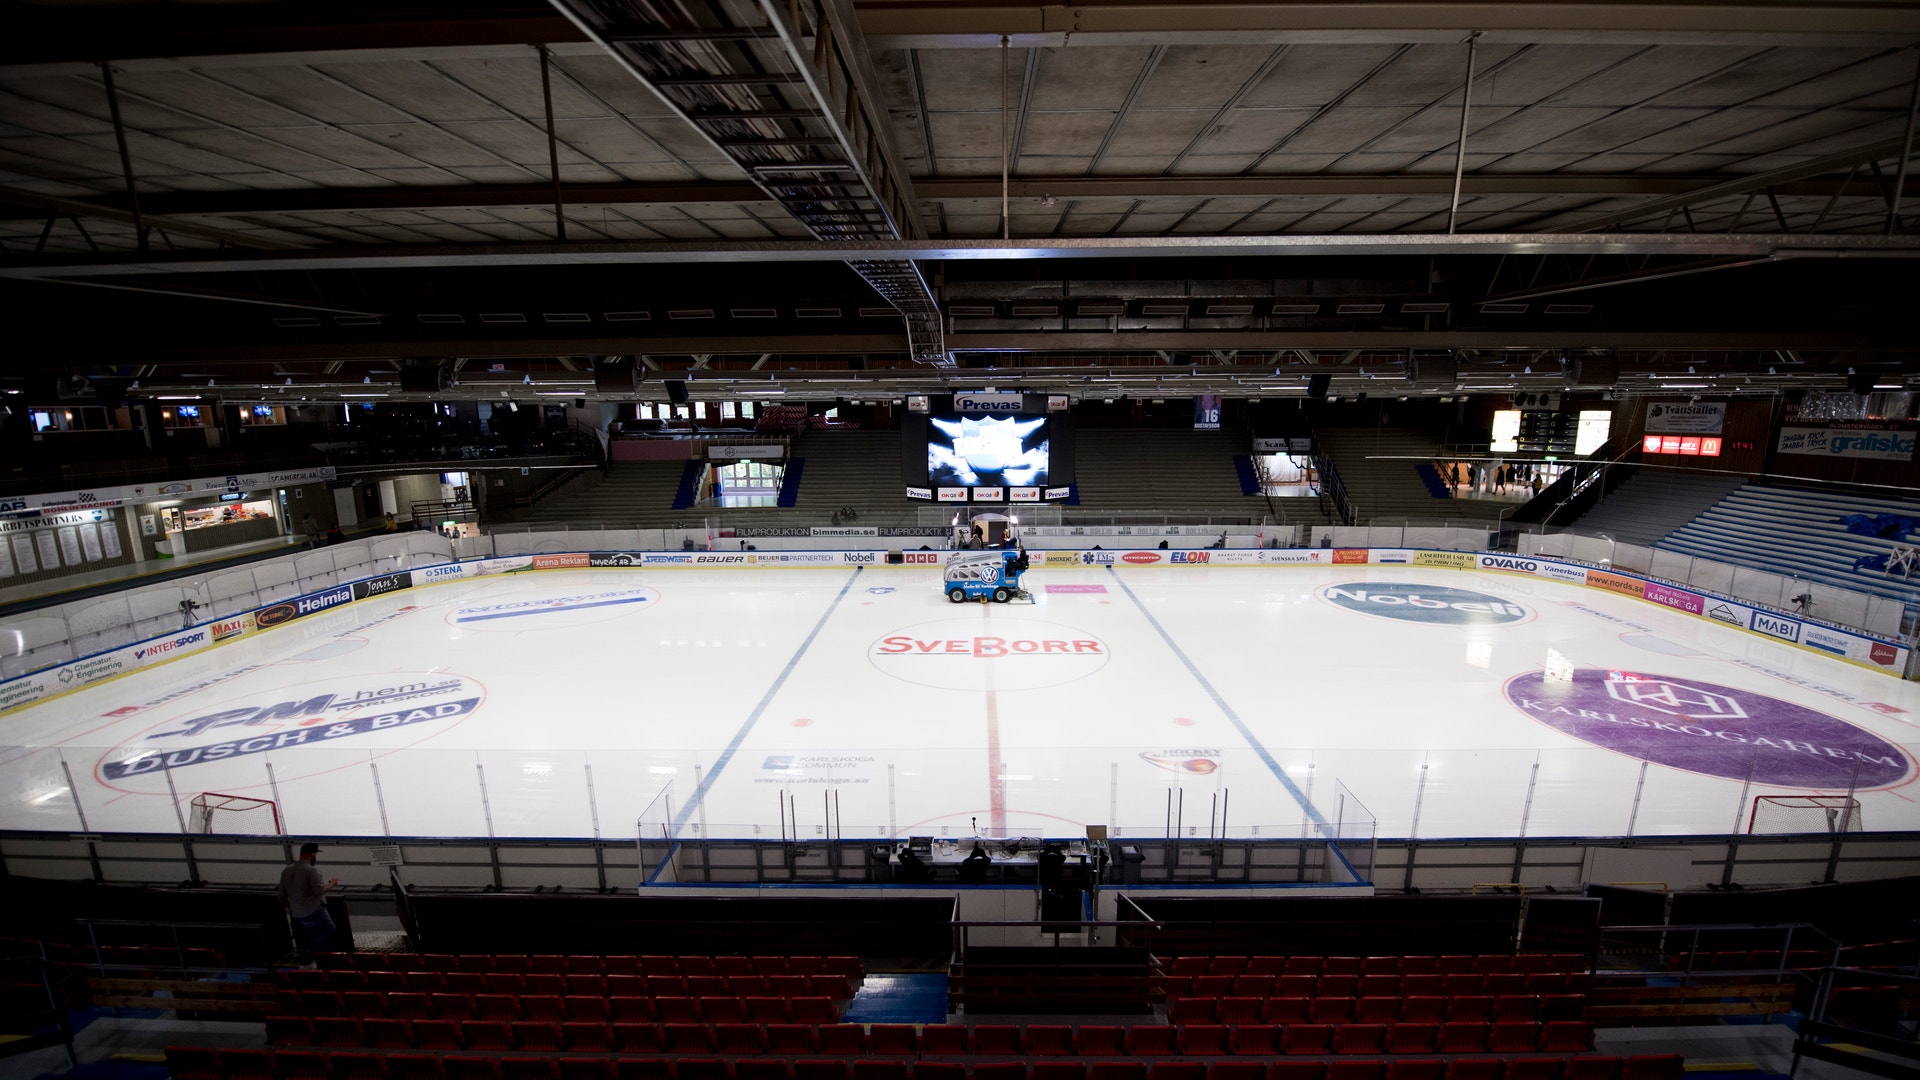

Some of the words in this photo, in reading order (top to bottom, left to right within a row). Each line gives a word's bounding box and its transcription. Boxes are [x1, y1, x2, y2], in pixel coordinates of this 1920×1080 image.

[962, 399, 1021, 410] Prevas
[1665, 406, 1718, 414] TvättStället
[1205, 409, 1218, 422] 16
[1830, 434, 1915, 454] grafiska
[910, 490, 931, 498] Prevas
[1048, 490, 1069, 498] Prevas
[736, 528, 808, 536] FILMPRODUKTION
[812, 528, 876, 536] bimmedia.se
[536, 558, 559, 567] Arena
[560, 556, 588, 566] Reklam
[844, 553, 874, 562] Nobeli
[1170, 552, 1211, 564] ELON
[1481, 556, 1538, 571] OVAKO
[434, 565, 463, 576] STENA
[1544, 564, 1585, 578] Vänerbuss
[365, 574, 400, 598] Joan's
[1587, 574, 1644, 593] www.nords.se
[298, 590, 350, 614] Helmia
[1327, 587, 1524, 616] Nobeli
[1648, 592, 1698, 612] KARLSKOGA
[212, 620, 241, 636] MAXI
[1758, 618, 1794, 637] MABI
[146, 632, 205, 657] INTERSPORT
[74, 656, 112, 672] Chematur
[76, 661, 122, 679] Engineering
[336, 688, 463, 712] KARLSKOGA
[122, 732, 307, 774] DUSCH
[326, 722, 354, 738] &
[374, 702, 464, 728] BAD
[1520, 698, 1901, 768] KARLSKOGAHEM
